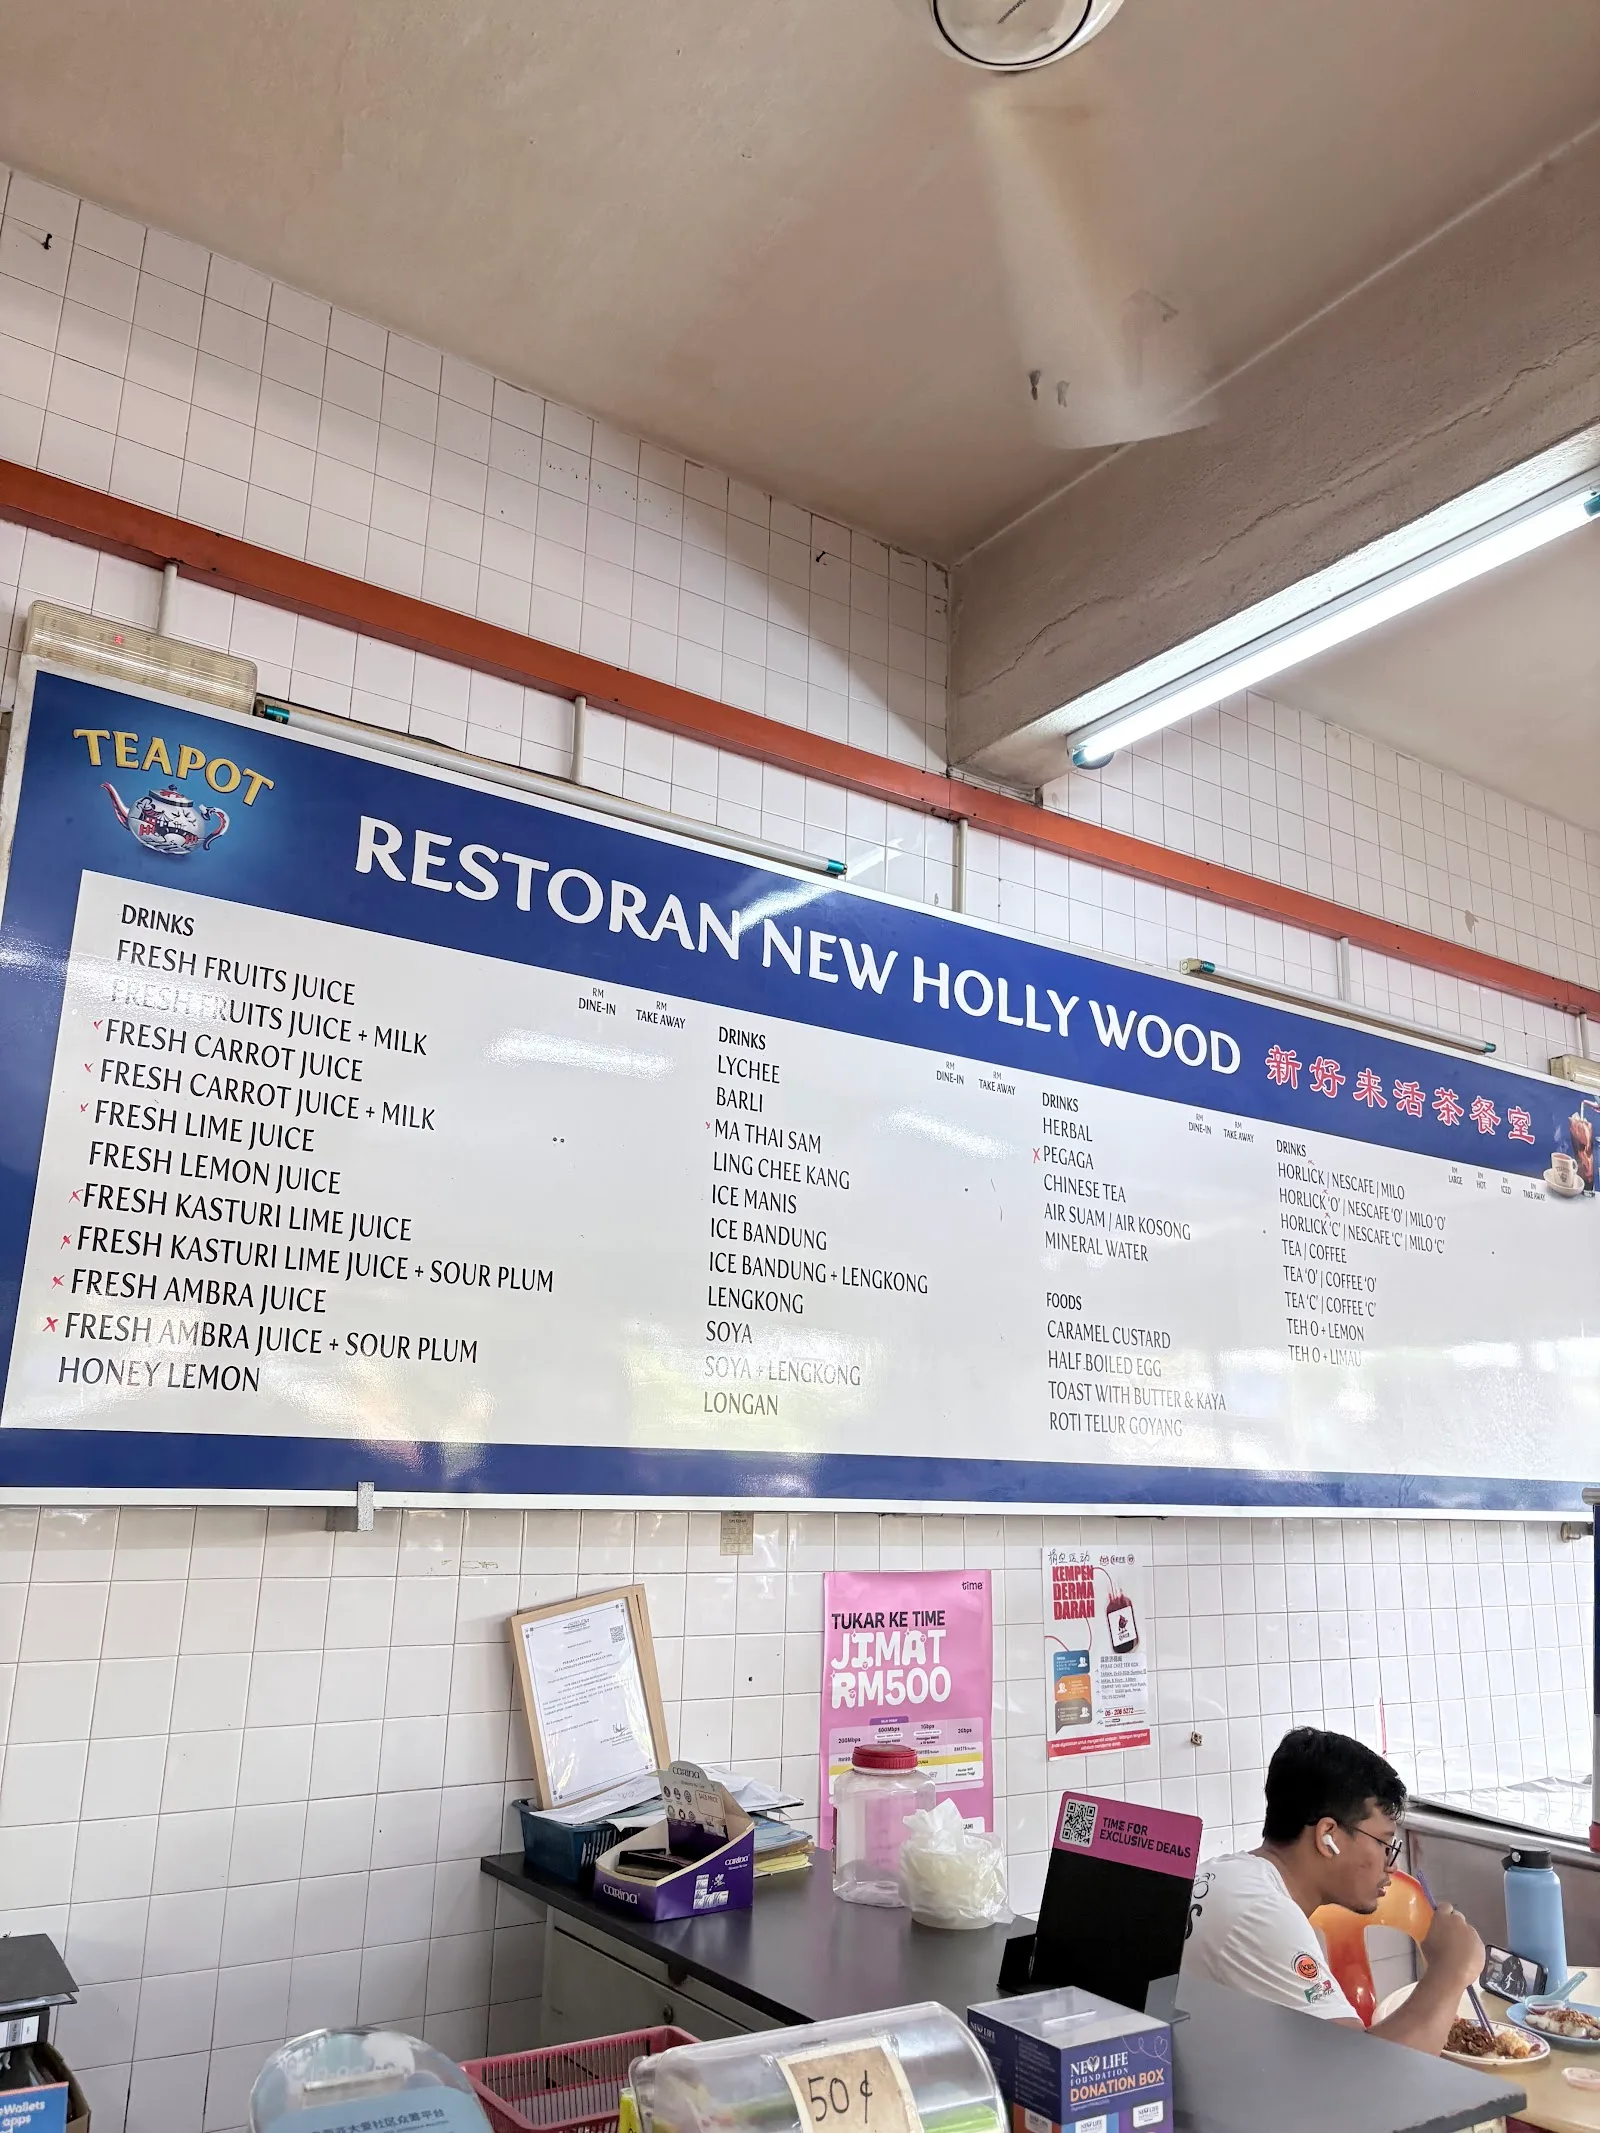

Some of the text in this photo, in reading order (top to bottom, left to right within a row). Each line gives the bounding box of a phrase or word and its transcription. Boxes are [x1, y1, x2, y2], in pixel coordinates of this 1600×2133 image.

[73, 728, 274, 806] TEAPOT
[121, 904, 194, 936] DRINKS
[354, 816, 1241, 1075] RESTORAN NEW HOLLY WOOD
[117, 939, 355, 1006] FRESH FRUITS JUICE
[592, 988, 604, 998] RM
[579, 998, 685, 1029] DINE-IN TAKE AWAY
[288, 1011, 351, 1042] JUICE
[374, 1026, 427, 1055] MILK
[719, 1026, 766, 1050] DRINKS
[106, 1019, 363, 1081] FRESH CARROT JUICE
[718, 1055, 780, 1084] LYCHEE
[937, 1071, 1016, 1095] DINE-IN TAKE AWAY
[100, 1059, 435, 1130] FRESH CARROT JUICE MILK
[716, 1087, 763, 1112] BARLI
[1042, 1092, 1079, 1113] DRINKS
[95, 1100, 314, 1152] FRESH LIME JUICE
[715, 1119, 821, 1154] MA THAI SAM
[1043, 1118, 1093, 1142] HERBAL
[1189, 1122, 1211, 1134] DINE-IN
[1223, 1129, 1237, 1140] TAKE
[1044, 1146, 1093, 1170] PEGAGA
[1277, 1140, 1306, 1157] DRINKS
[89, 1141, 340, 1194] FRESH LEMON JUICE
[714, 1152, 850, 1189] LING CHEE KANG
[1278, 1162, 1404, 1200] HORLICK NESCAFE MILO
[712, 1185, 797, 1214] ICE MANIS
[1044, 1174, 1126, 1203] CHINESE TEA
[83, 1183, 412, 1241] FRESH KASTURI LIME JUICE
[1044, 1203, 1191, 1240] AIR SUAM AIR KOSONG
[1280, 1188, 1432, 1229] HORLICK NESCAFE MILO
[711, 1218, 827, 1250] ICE BANDUNG
[1045, 1231, 1148, 1262] MINERAL WATER
[1281, 1213, 1432, 1252] HORLICK NESCAFE MILO
[77, 1226, 553, 1292] FRESH KASTURI LIME JUICE SOUR PLUM
[1282, 1239, 1347, 1263] TEA COFFEE
[710, 1252, 928, 1294] ICE BANDUNG LENGKONG
[1283, 1265, 1363, 1290] TEA COFFEE
[71, 1269, 326, 1315] FRESH AMBRA JUICE
[708, 1286, 803, 1314] LENGKONG
[1047, 1292, 1082, 1310] FOODS
[1285, 1292, 1364, 1316] TEA COFFEE
[65, 1312, 477, 1363] FRESH AMBRA JUICE SOUR PLUM
[706, 1320, 752, 1344] SOYA
[1048, 1320, 1170, 1349] CARAMEL CUSTARD
[1286, 1318, 1364, 1341] TEH O LEMON
[1049, 1350, 1162, 1377] HALF BOILED EGG
[1288, 1345, 1361, 1367] TEH O LIMAU
[58, 1356, 260, 1392] HONEY LEMON
[704, 1356, 860, 1386] SOYA LENGKONG
[704, 1392, 778, 1416] LONGAN
[1048, 1381, 1092, 1401] TOAST
[1096, 1385, 1130, 1404] WITH
[1135, 1388, 1182, 1408] BUTTER
[1197, 1392, 1226, 1411] KAYA
[1050, 1412, 1182, 1437] ROTI TELUR GOYANG
[962, 1581, 983, 1590] time
[1052, 1565, 1093, 1581] KEMPEN
[1053, 1582, 1094, 1600] DERMA
[832, 1610, 946, 1629] TUKAR KE TIME
[1054, 1600, 1095, 1620] DARAH
[831, 1629, 946, 1670] JIMAT
[830, 1666, 951, 1709] RM500
[1103, 1817, 1148, 1836] TIME FOR
[1100, 1829, 1190, 1858] EXCLUSIVE DEALS
[1103, 2052, 1128, 2069] LIFE
[1070, 2068, 1164, 2102] DONATION BOX
[1071, 2068, 1128, 2086] FOUNDATION
[2, 2115, 31, 2128] apps
